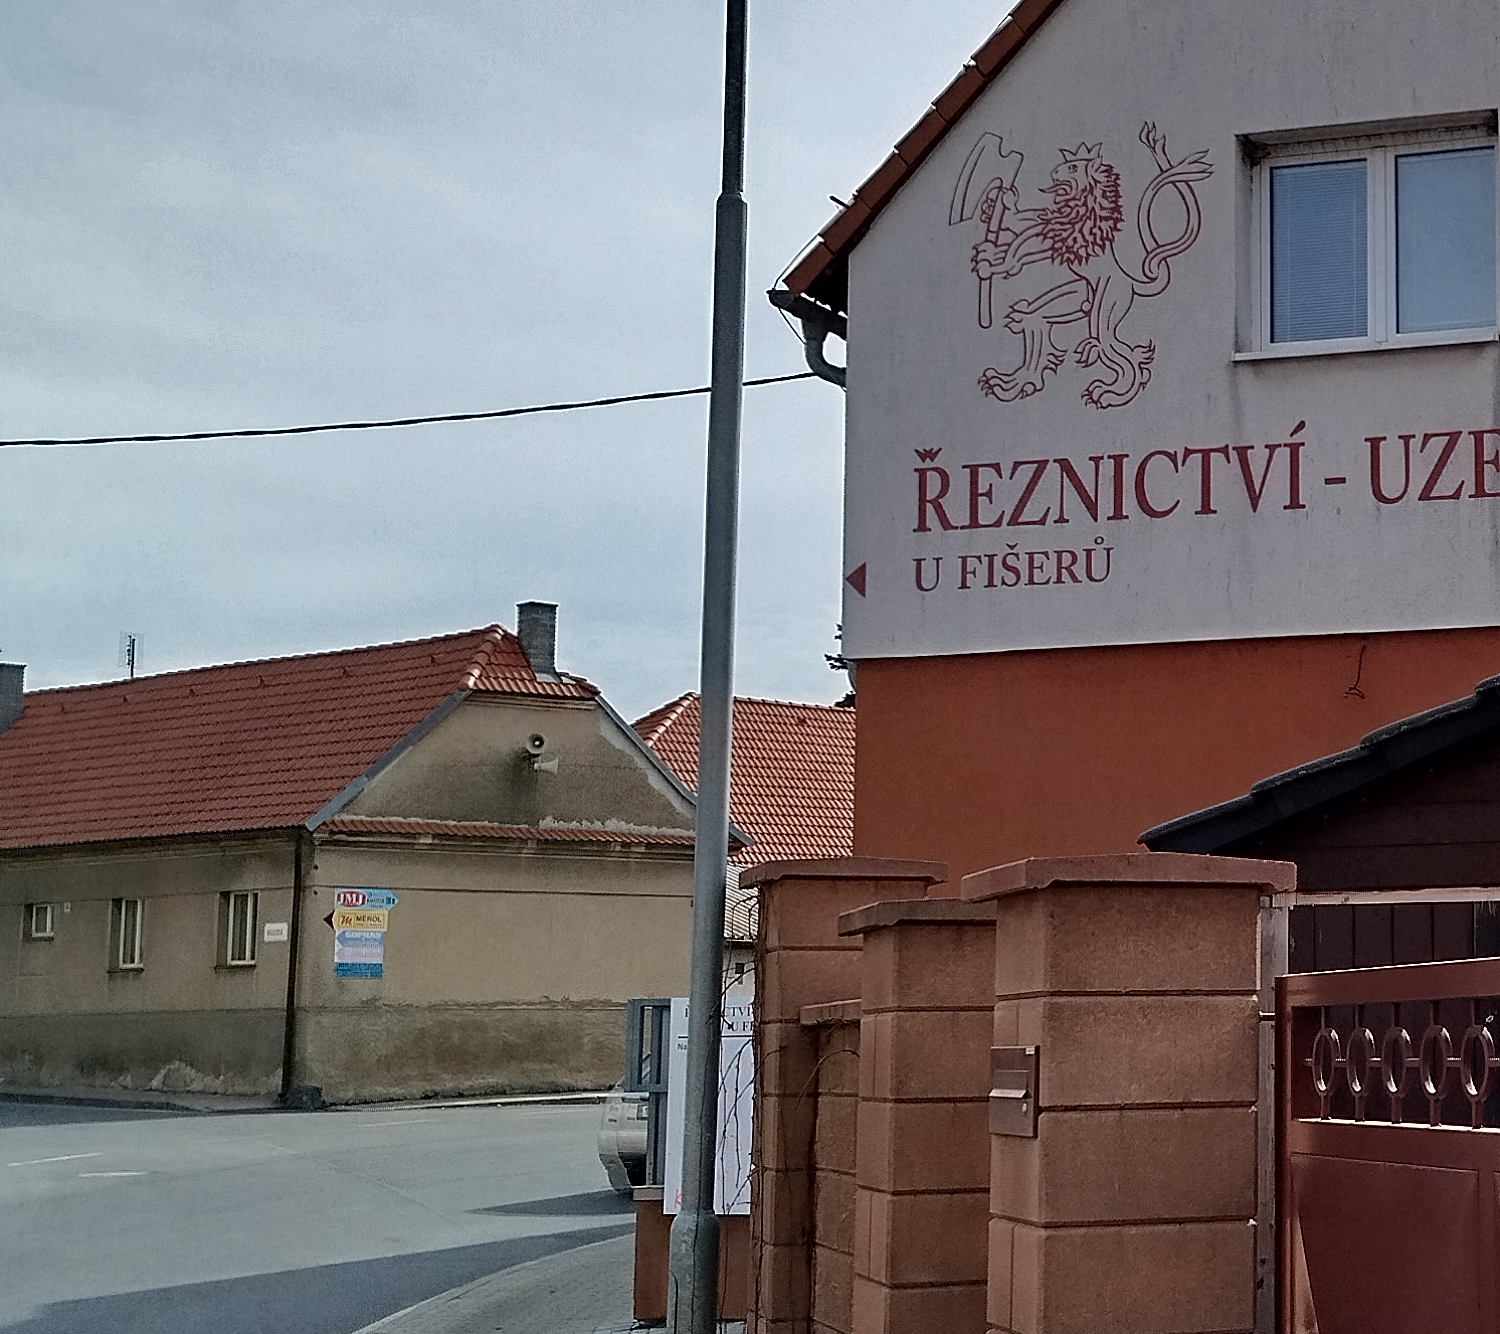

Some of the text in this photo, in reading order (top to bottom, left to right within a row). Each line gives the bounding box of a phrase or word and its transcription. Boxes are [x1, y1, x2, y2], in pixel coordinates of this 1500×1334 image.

[911, 420, 1307, 533] ŘEZNICTVÍ
[912, 535, 1115, 592] U FIŠERŮ
